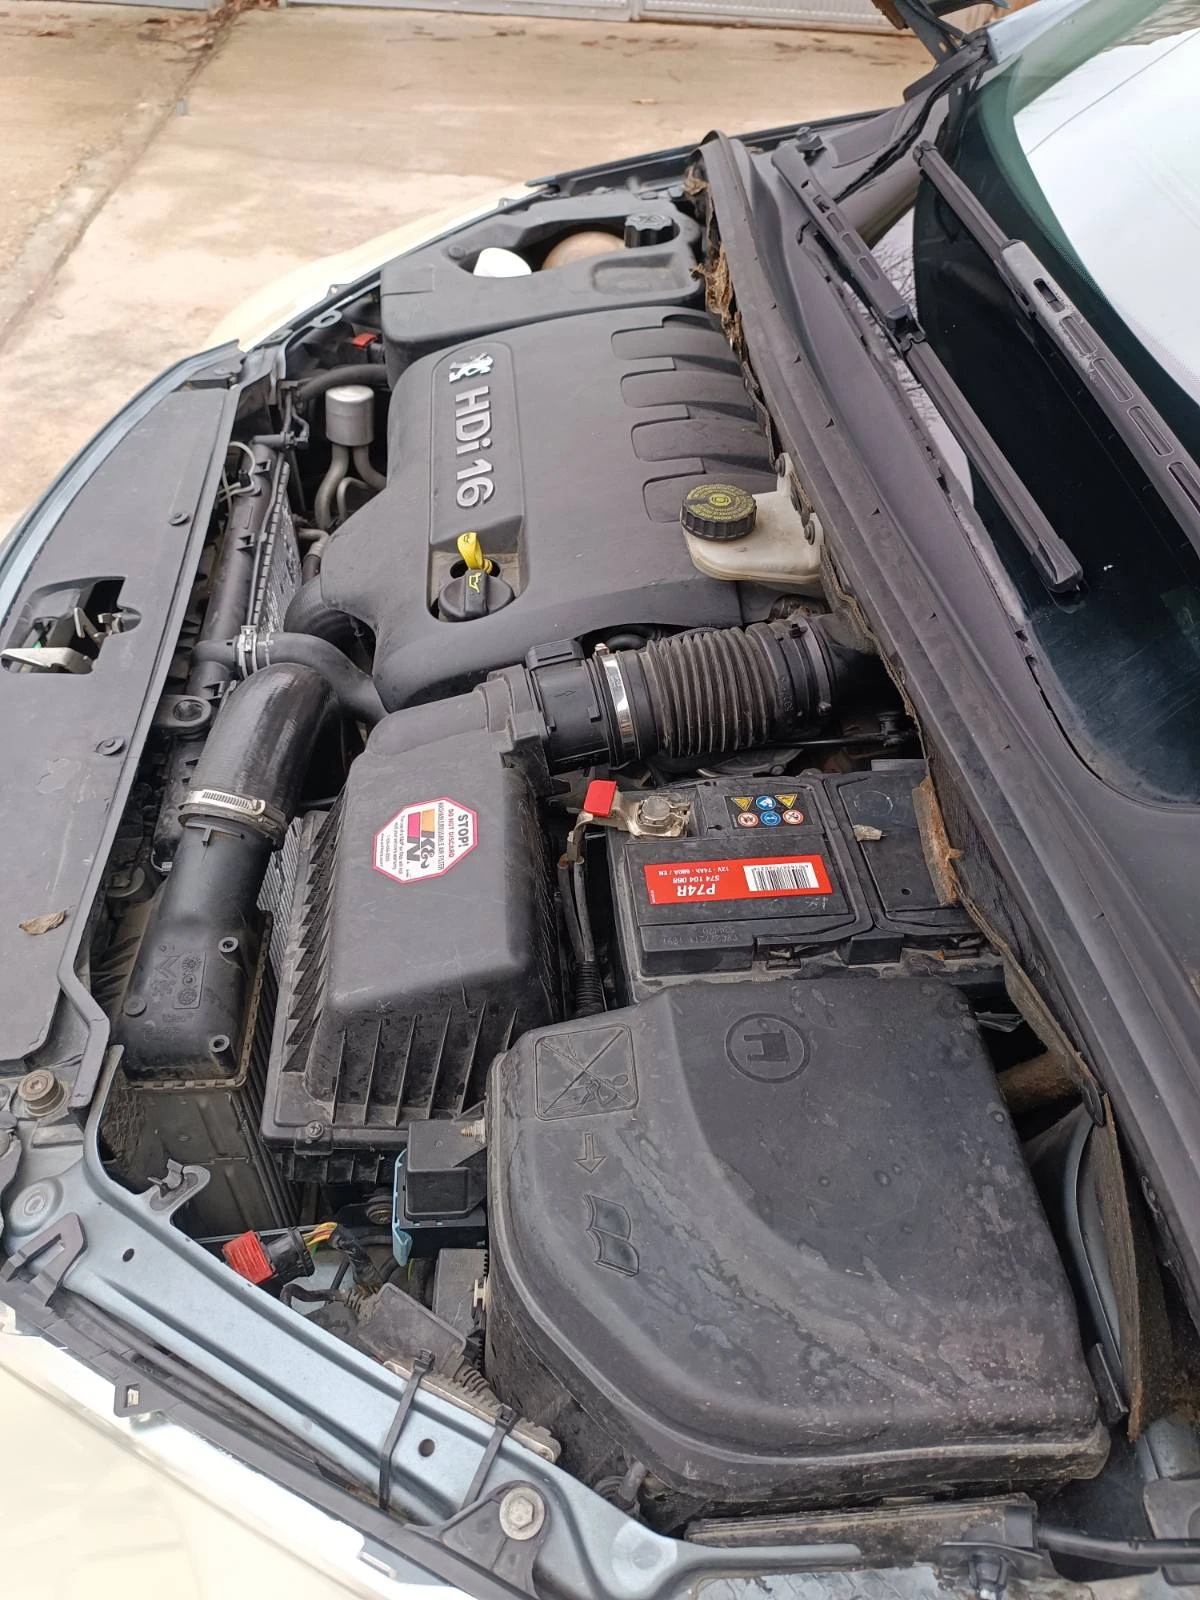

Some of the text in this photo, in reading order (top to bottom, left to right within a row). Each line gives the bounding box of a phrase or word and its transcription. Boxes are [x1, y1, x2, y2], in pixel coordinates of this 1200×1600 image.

[455, 385, 495, 507] HDi 16
[448, 808, 454, 817] DO
[458, 814, 469, 848] STOP!
[406, 831, 436, 869] K&N
[695, 867, 713, 875] 74Ah
[718, 866, 730, 874] 12V
[689, 875, 704, 884] 104
[706, 874, 720, 883] 574
[676, 883, 716, 897] P74R
